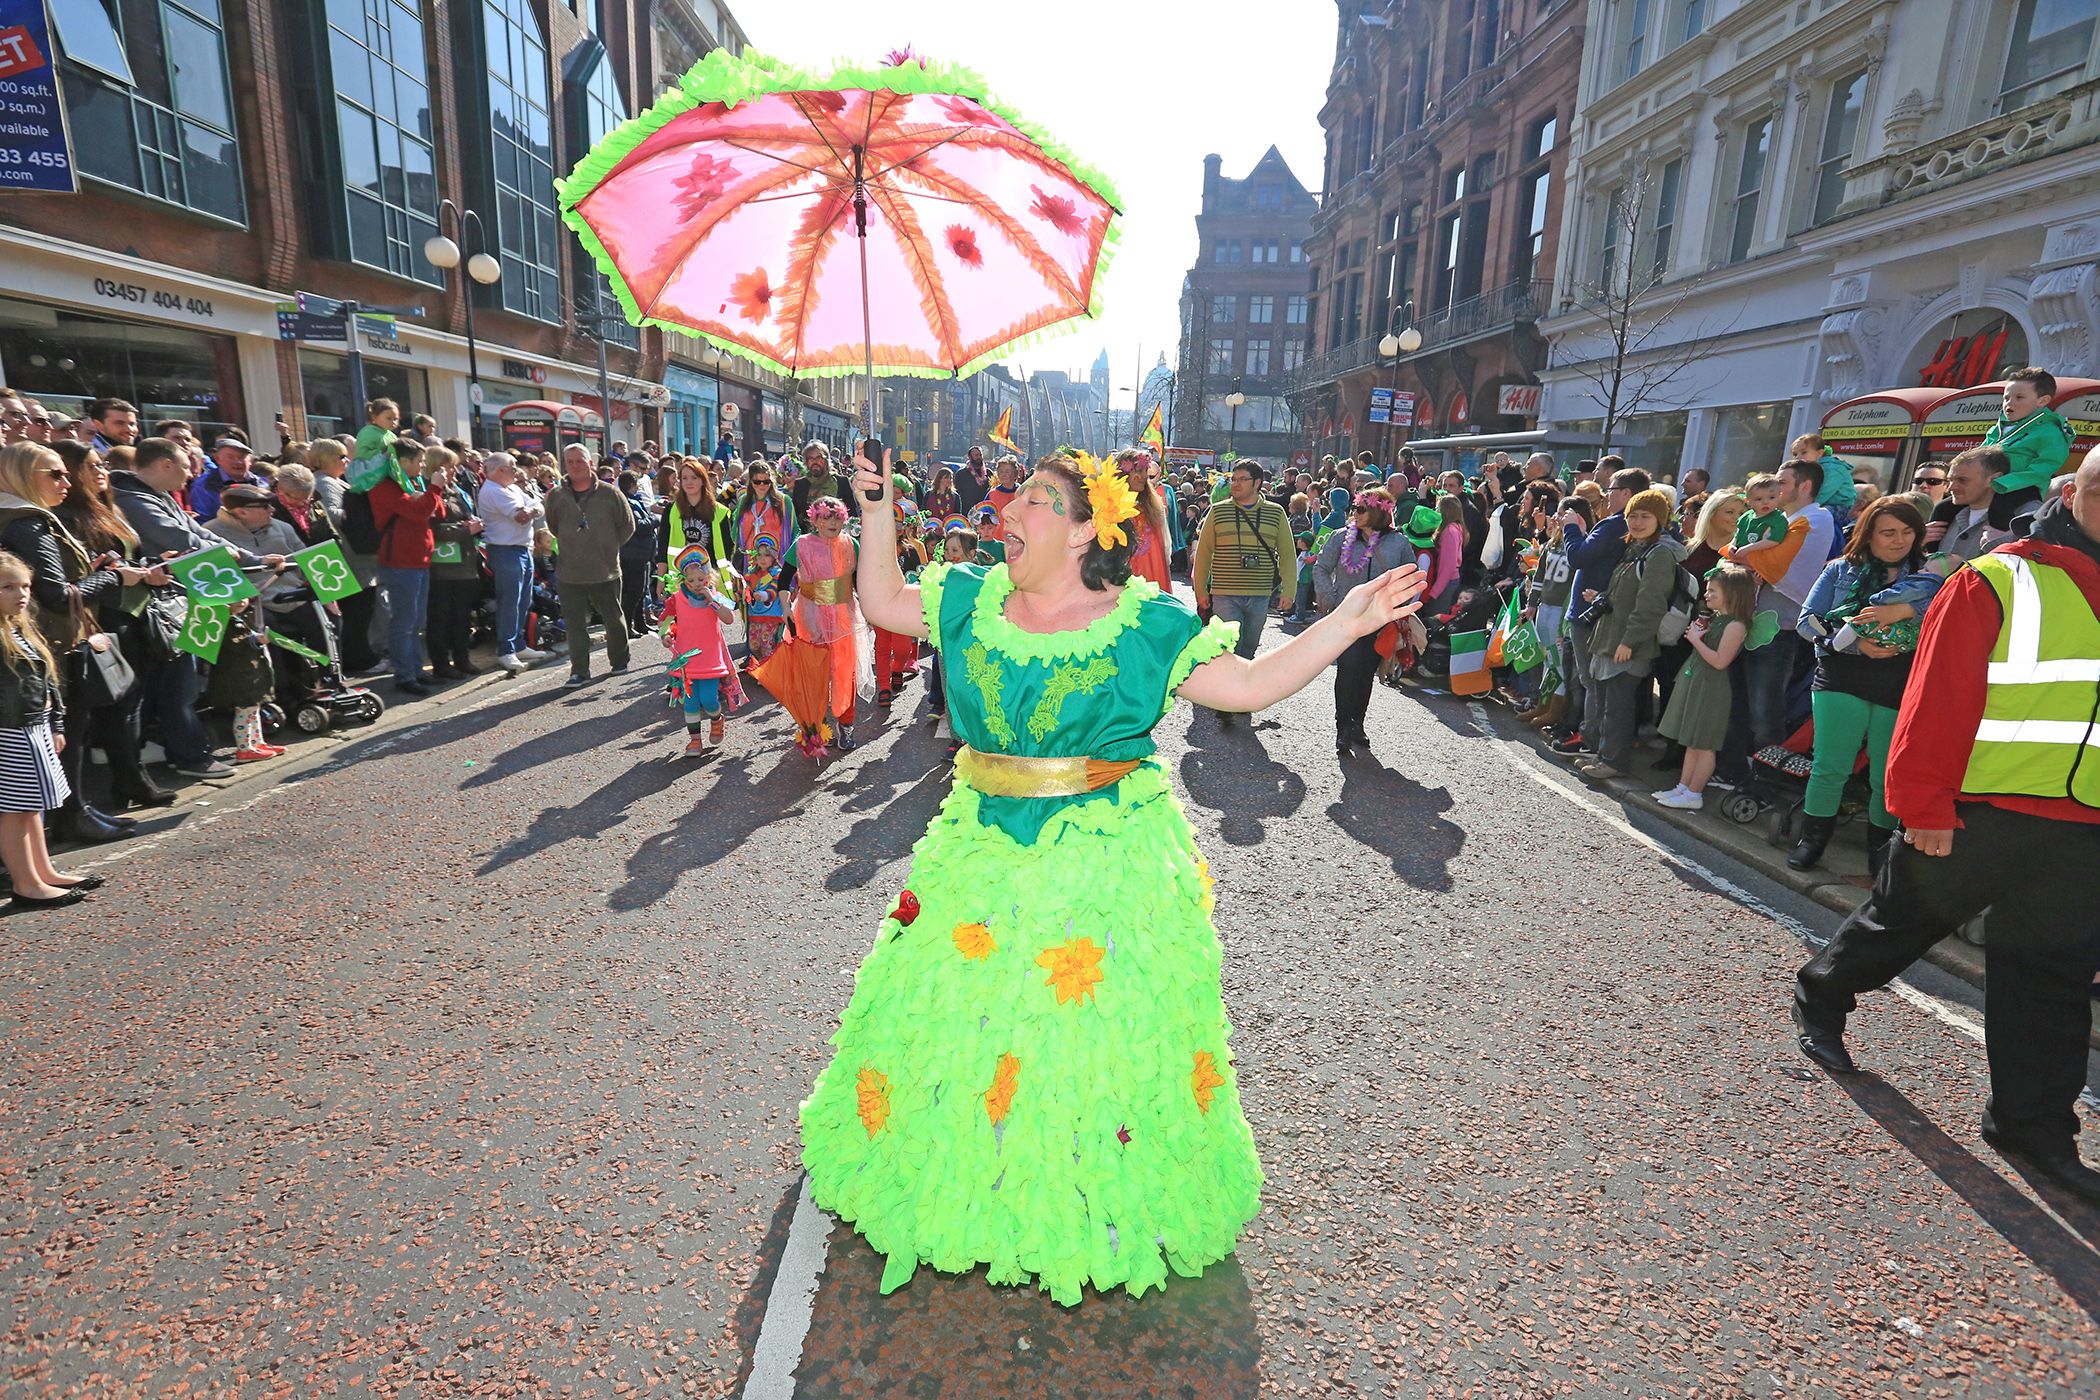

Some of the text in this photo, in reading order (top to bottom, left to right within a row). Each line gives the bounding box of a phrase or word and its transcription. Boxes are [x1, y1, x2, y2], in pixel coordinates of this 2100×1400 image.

[21, 84, 53, 98] sq.ft.
[9, 102, 46, 115] sq.m.)
[28, 151, 67, 168] 455
[0, 169, 33, 181] .com
[94, 278, 214, 317] 03457 404 404
[367, 334, 412, 355] hsbc.co.uk
[1919, 328, 2009, 388] H&M
[1505, 388, 1538, 411] H&M
[1848, 409, 1889, 421] Telephone
[1956, 401, 2002, 415] Telephon
[1840, 429, 1855, 437] ALSO
[1857, 427, 1889, 436] ACCEPTED
[1890, 426, 1907, 435] HERE
[1924, 424, 1991, 434] EURO ALSO ACCEP
[2074, 423, 2094, 433] ALSO
[1945, 440, 1983, 448] www.bt.c
[1545, 551, 1570, 583] 76
